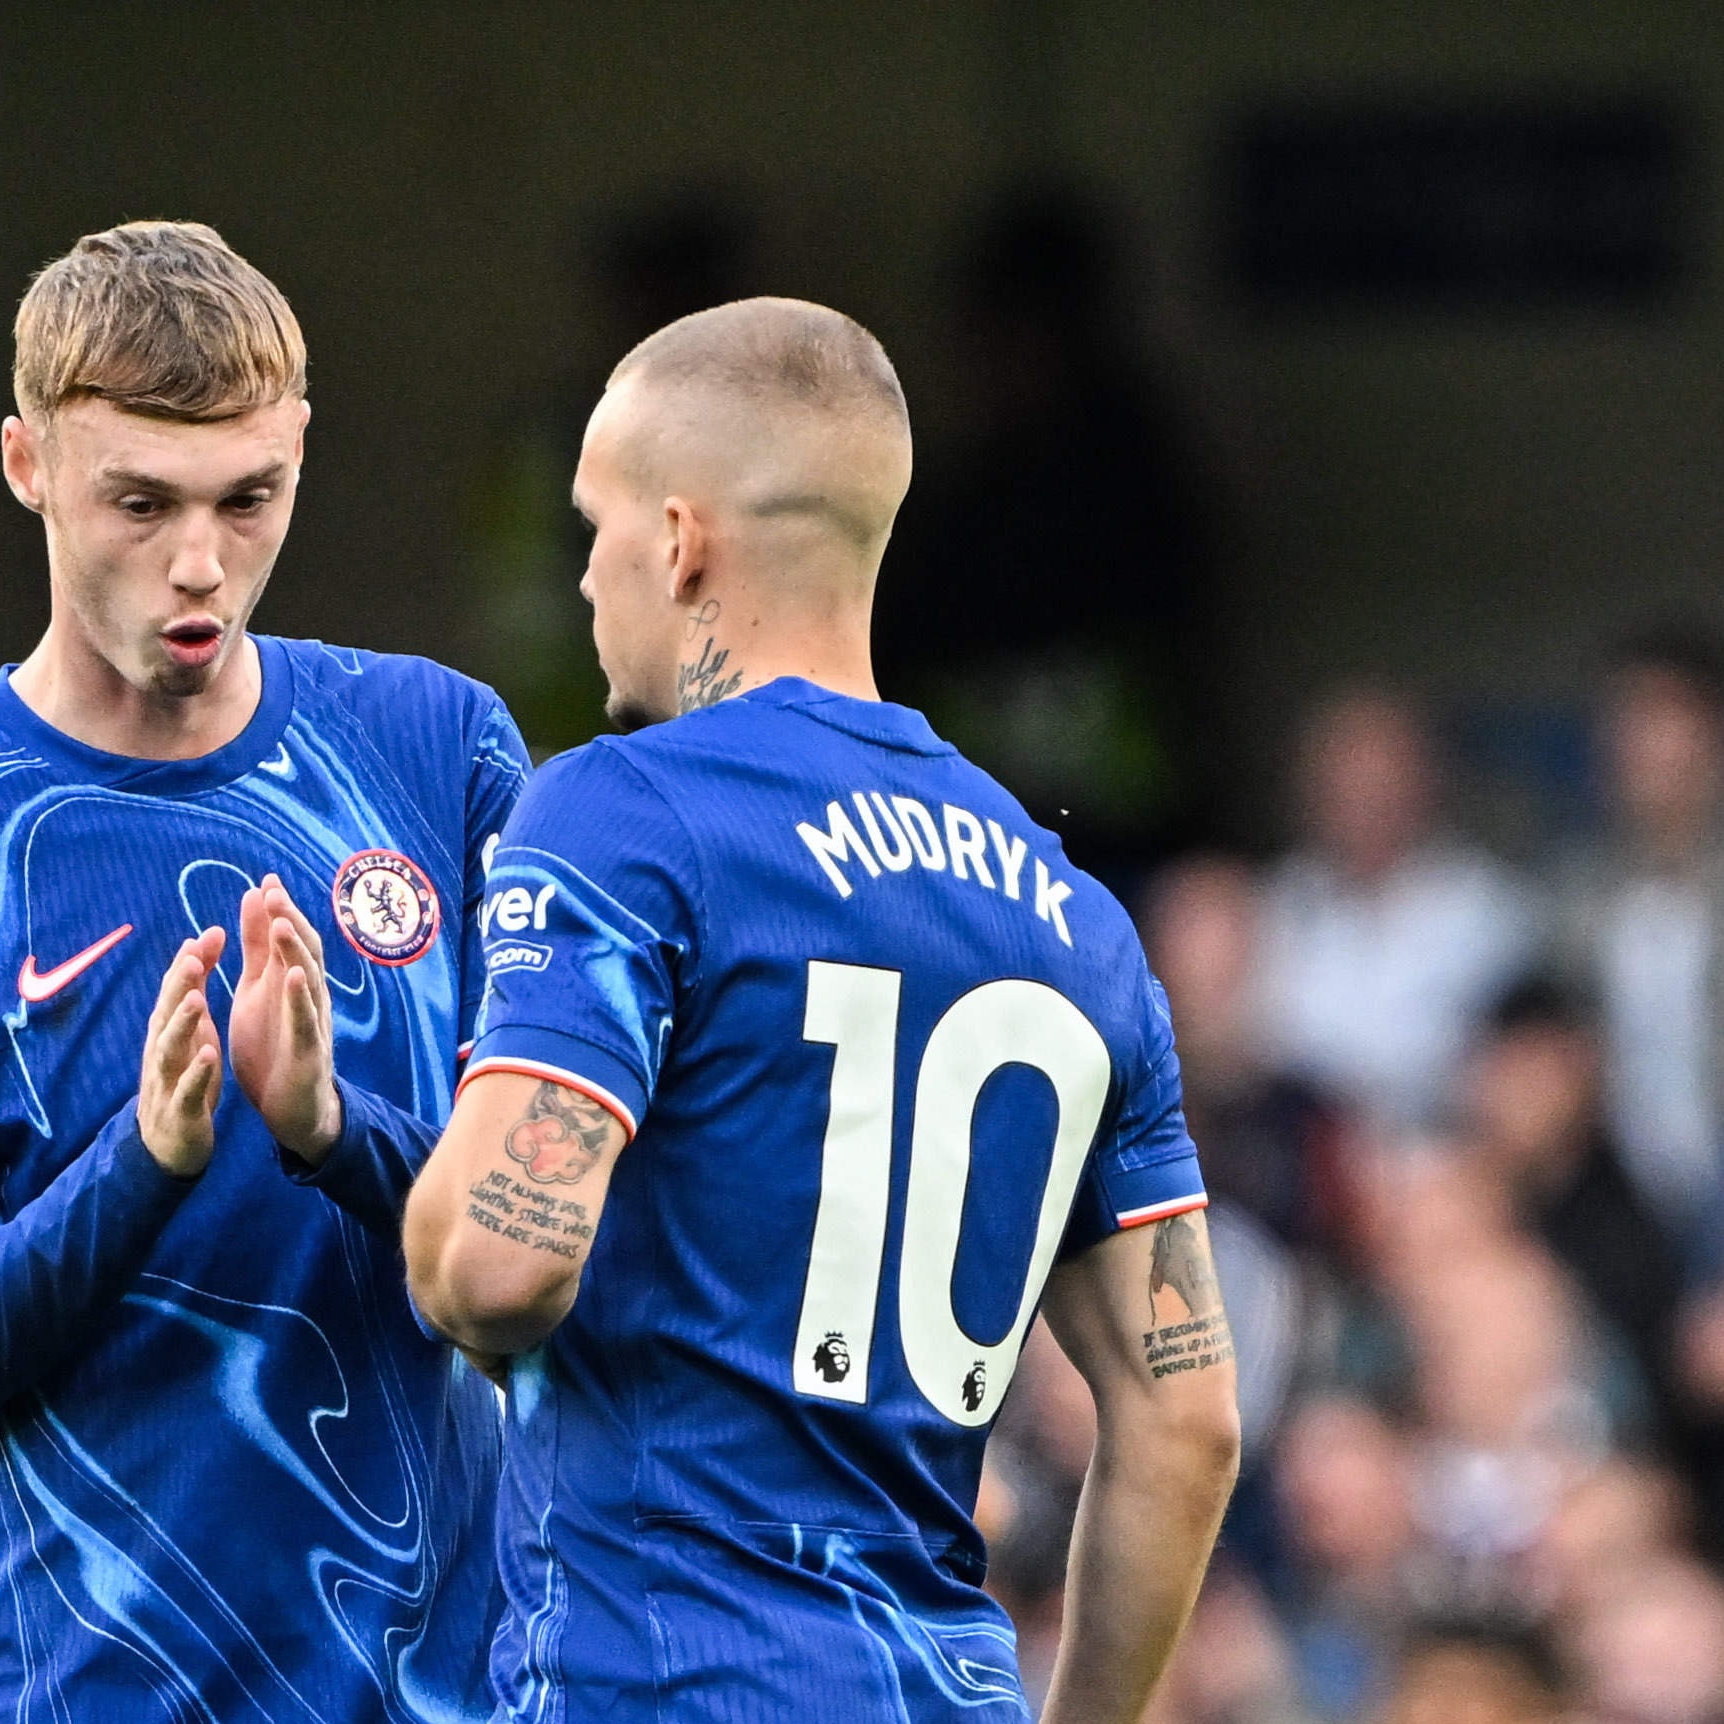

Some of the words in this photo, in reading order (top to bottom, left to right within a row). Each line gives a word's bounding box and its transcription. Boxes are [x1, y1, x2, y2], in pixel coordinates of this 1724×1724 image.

[348, 855, 412, 880] CHELSEA
[795, 792, 1075, 949] MUDRYK
[792, 958, 1112, 1428] 10
